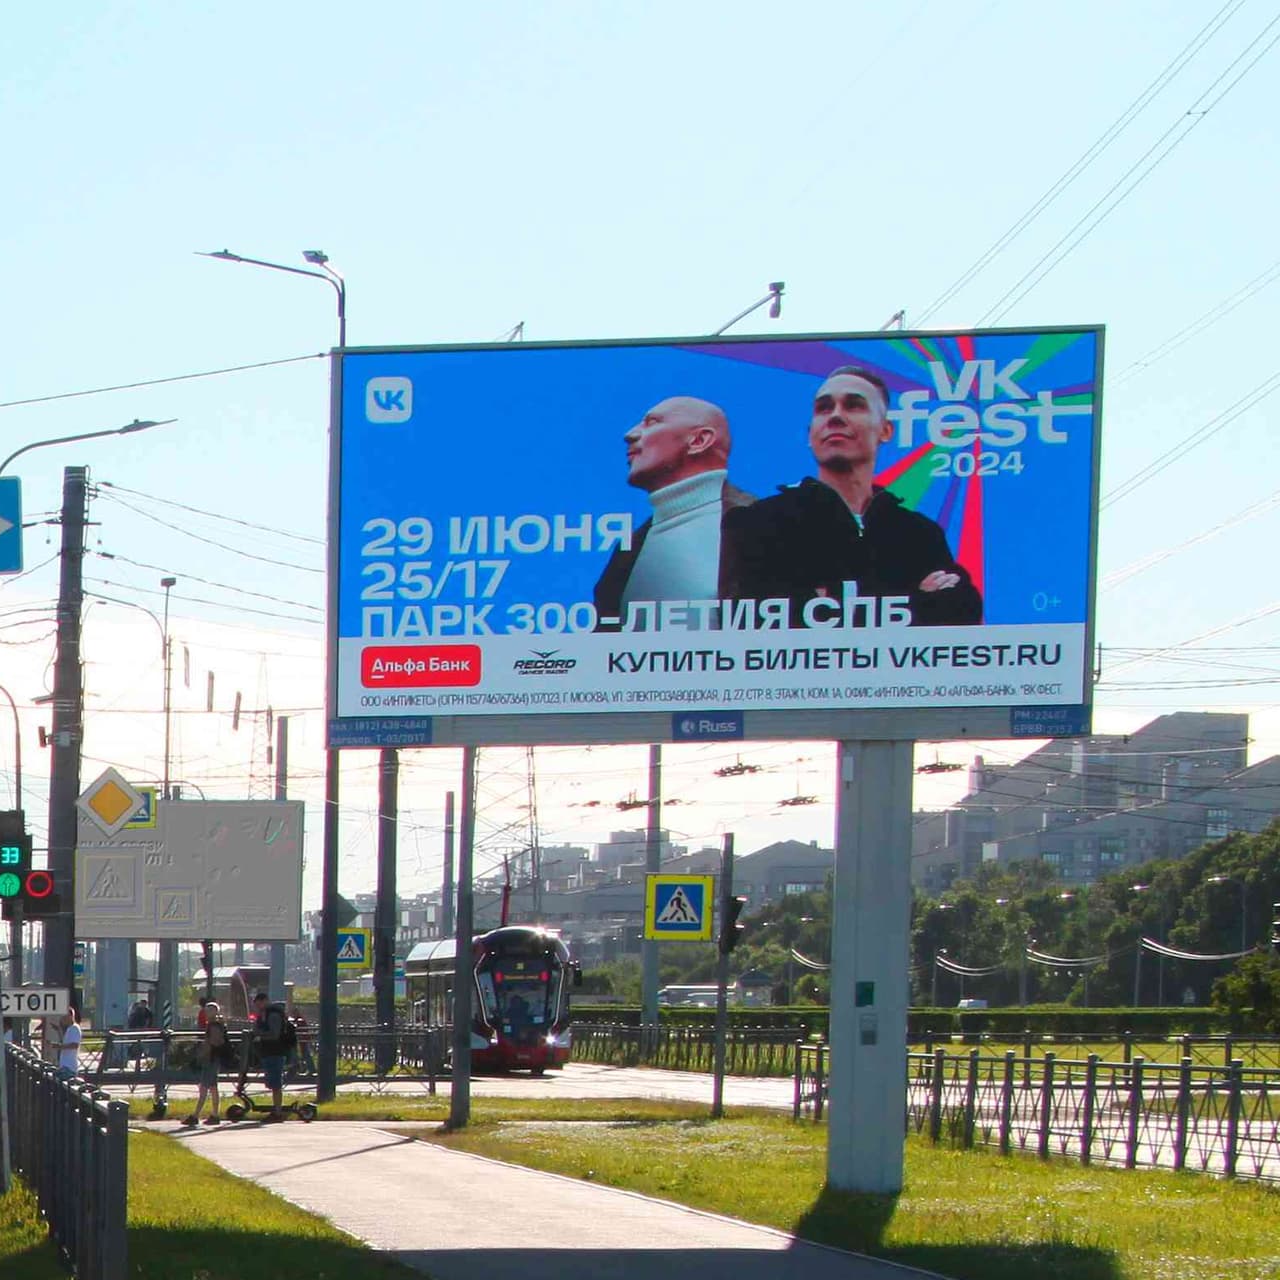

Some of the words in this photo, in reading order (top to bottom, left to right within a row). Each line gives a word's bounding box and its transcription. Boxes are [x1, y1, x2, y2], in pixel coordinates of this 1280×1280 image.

[928, 358, 1031, 401] VK
[886, 390, 1094, 448] fest
[929, 451, 1025, 477] 2024
[360, 516, 433, 557] 29
[449, 512, 633, 555] ИЮНЯ
[360, 559, 511, 601] 25/17
[1032, 592, 1062, 611] 0+
[361, 603, 497, 638] ПАРК
[506, 596, 790, 635] 300-ЛЕТИЯ
[802, 593, 914, 629] СПБ
[371, 657, 425, 675] Альфа
[428, 657, 471, 672] Банк
[513, 658, 577, 670] RECORD
[608, 650, 736, 674] КУПИТЬ
[744, 646, 878, 671] БИЛЕТЫ
[890, 643, 1062, 668] VKFEST.RU
[361, 695, 381, 707] ООО
[699, 719, 737, 733] Russ
[1, 847, 19, 864] 33
[1, 993, 57, 1012] СТОП
